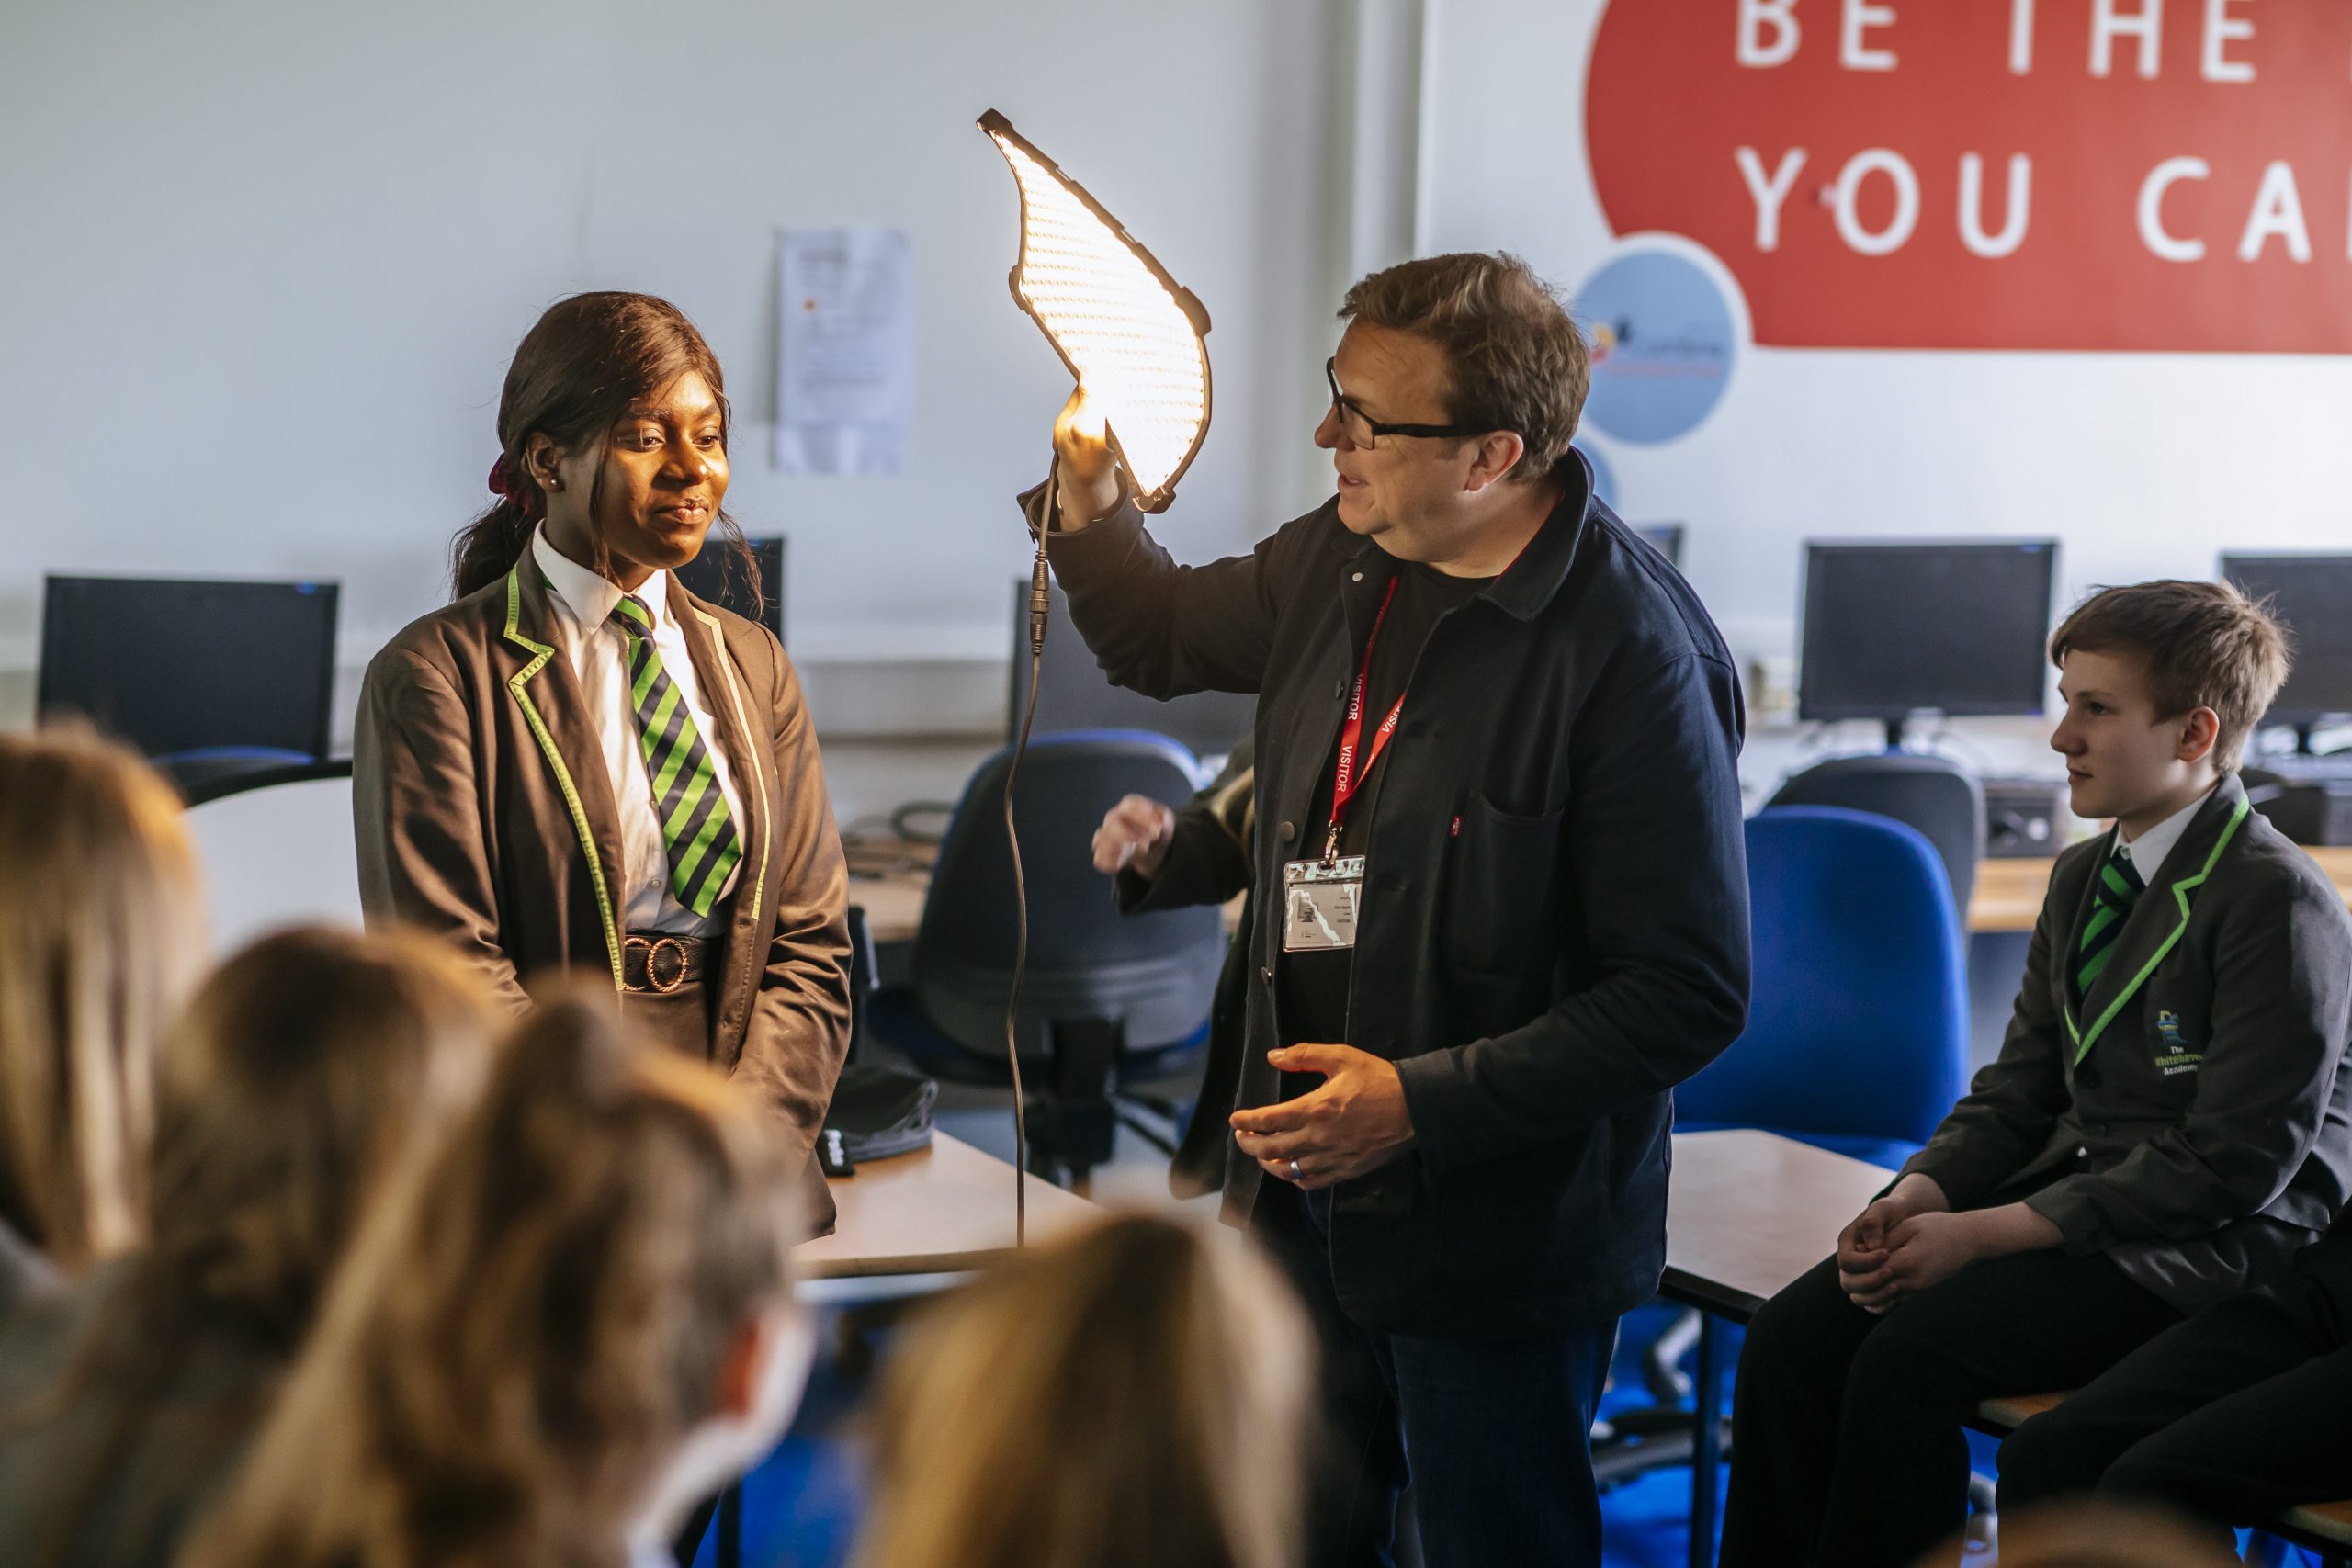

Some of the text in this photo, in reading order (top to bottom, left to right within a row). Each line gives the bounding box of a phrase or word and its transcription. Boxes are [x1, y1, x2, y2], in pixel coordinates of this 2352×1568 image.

[1736, 0, 1897, 68] BE
[1734, 146, 2352, 263] YOU CA
[1348, 673, 1363, 721] VISITOR
[1337, 745, 1353, 793] VISITOR
[2164, 1065, 2199, 1076] Academy
[2171, 1045, 2184, 1055] The
